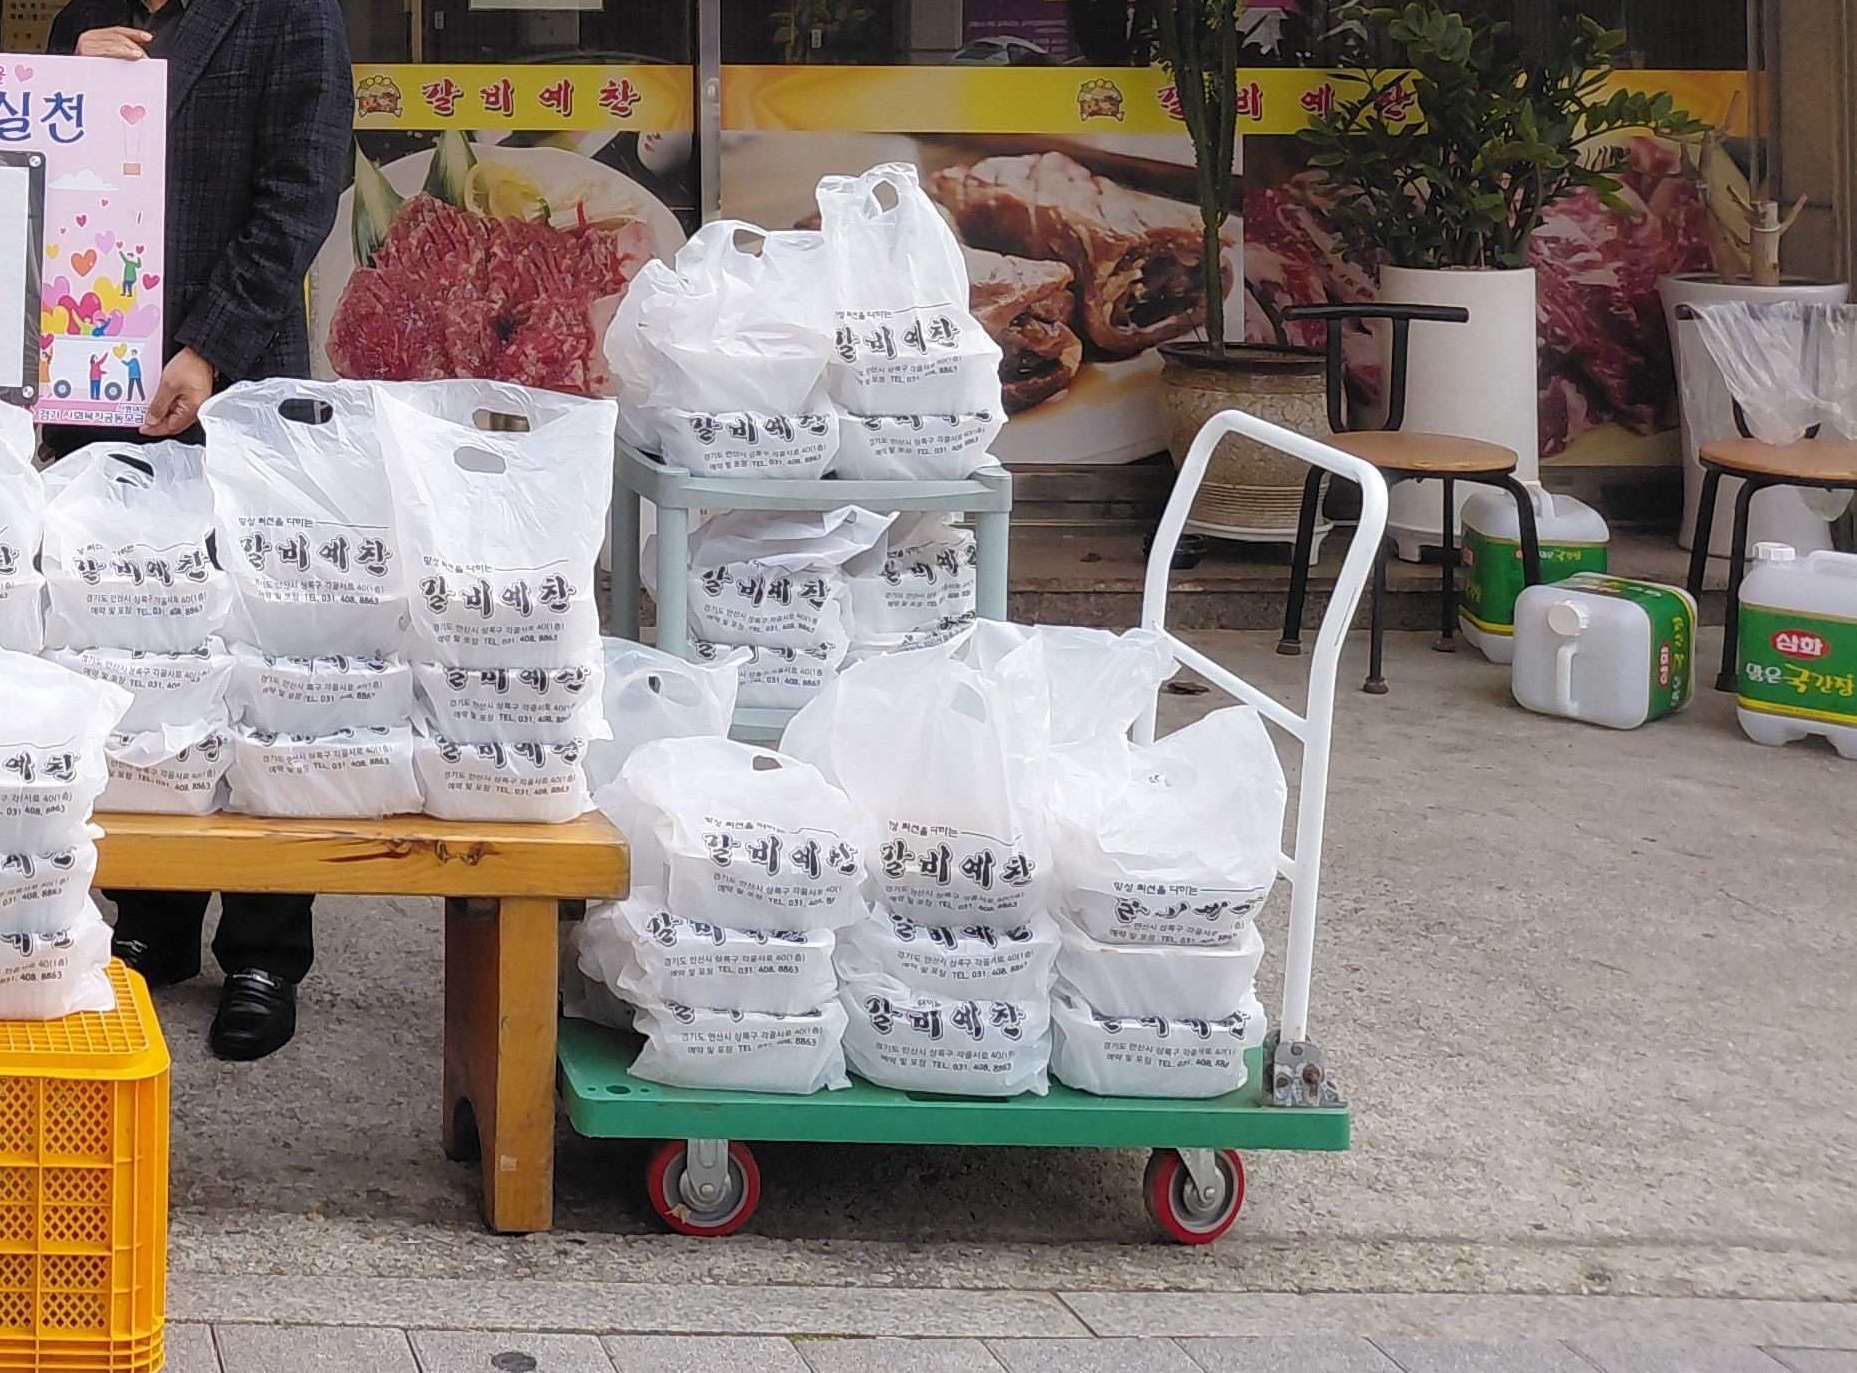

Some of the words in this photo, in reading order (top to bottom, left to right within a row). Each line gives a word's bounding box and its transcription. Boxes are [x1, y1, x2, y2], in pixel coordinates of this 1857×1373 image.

[421, 77, 641, 119] 갈비예찬
[239, 531, 393, 577] 갈비예찬
[419, 572, 577, 619] 갈비예찬
[1774, 631, 1825, 655] 삼화
[1785, 662, 1856, 695] 국간장
